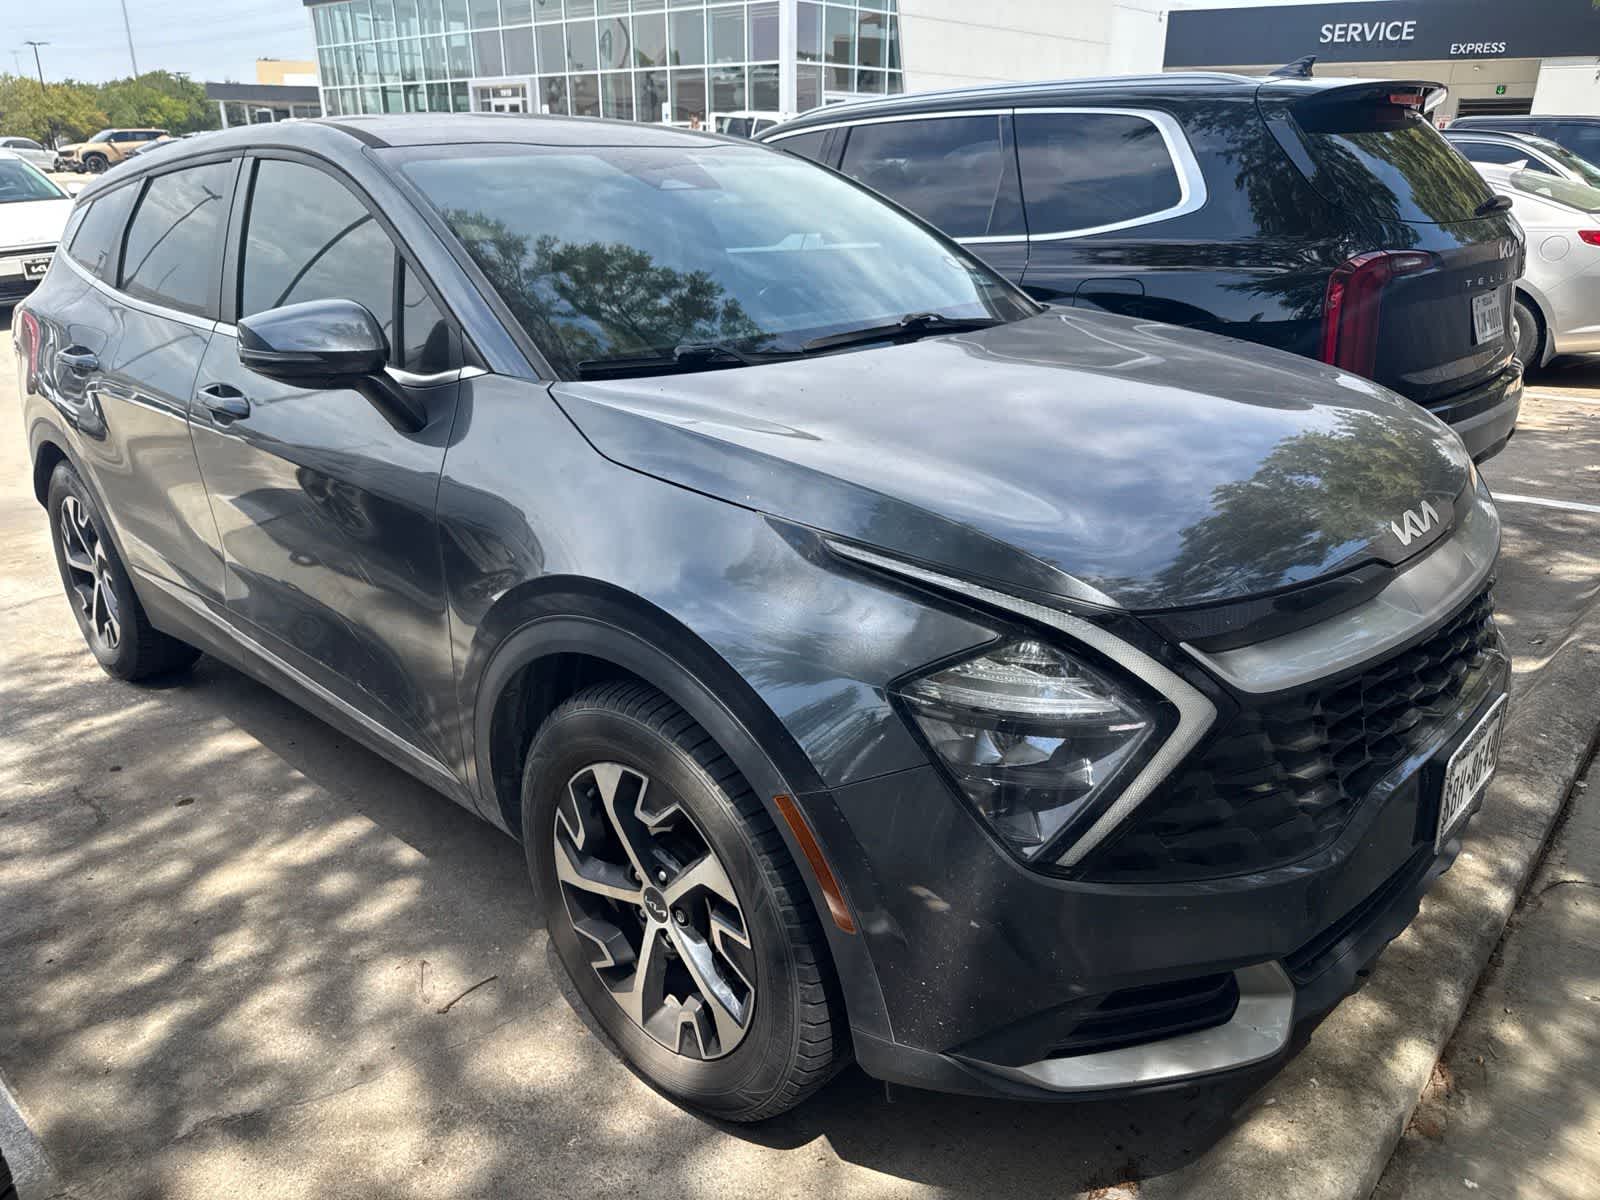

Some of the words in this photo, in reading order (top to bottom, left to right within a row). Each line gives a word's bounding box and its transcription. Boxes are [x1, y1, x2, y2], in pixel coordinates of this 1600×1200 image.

[1319, 20, 1417, 43] SERVICE
[1450, 41, 1507, 54] EXPRESS
[1391, 500, 1439, 546] KIA
